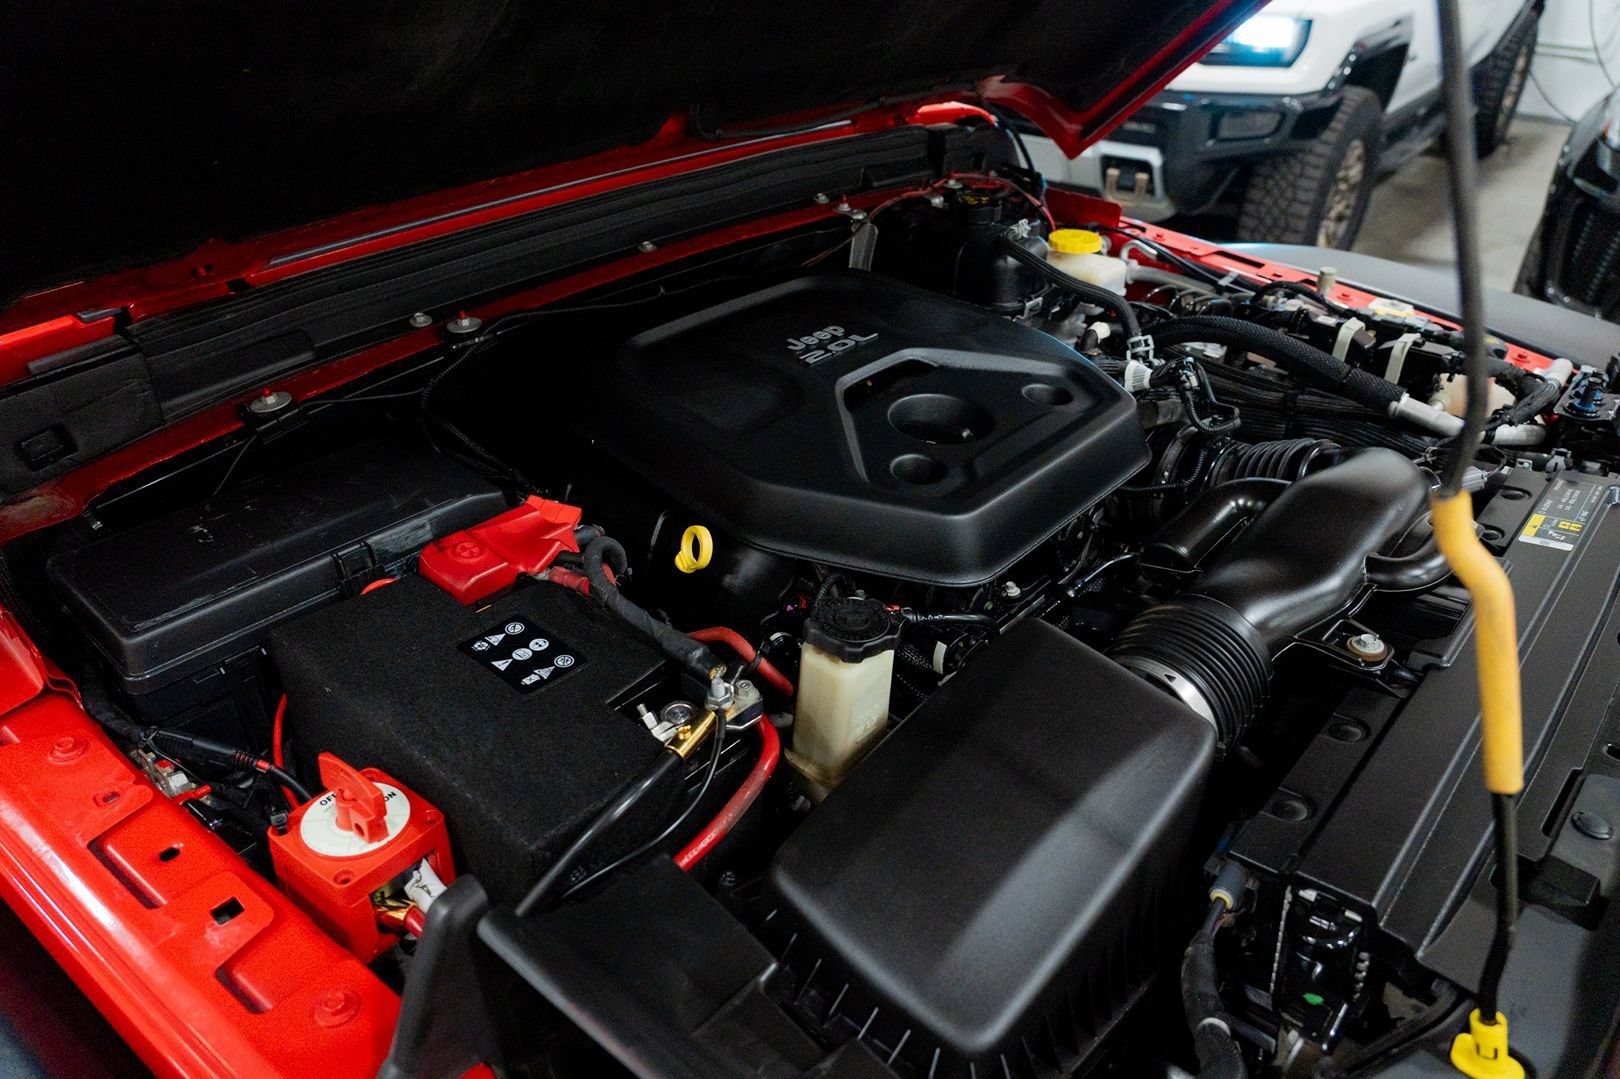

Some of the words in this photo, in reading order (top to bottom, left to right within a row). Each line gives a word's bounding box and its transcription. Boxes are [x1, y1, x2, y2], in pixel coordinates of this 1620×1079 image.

[786, 325, 845, 350] Jeep
[799, 333, 879, 364] 2.0L
[384, 791, 397, 802] ON
